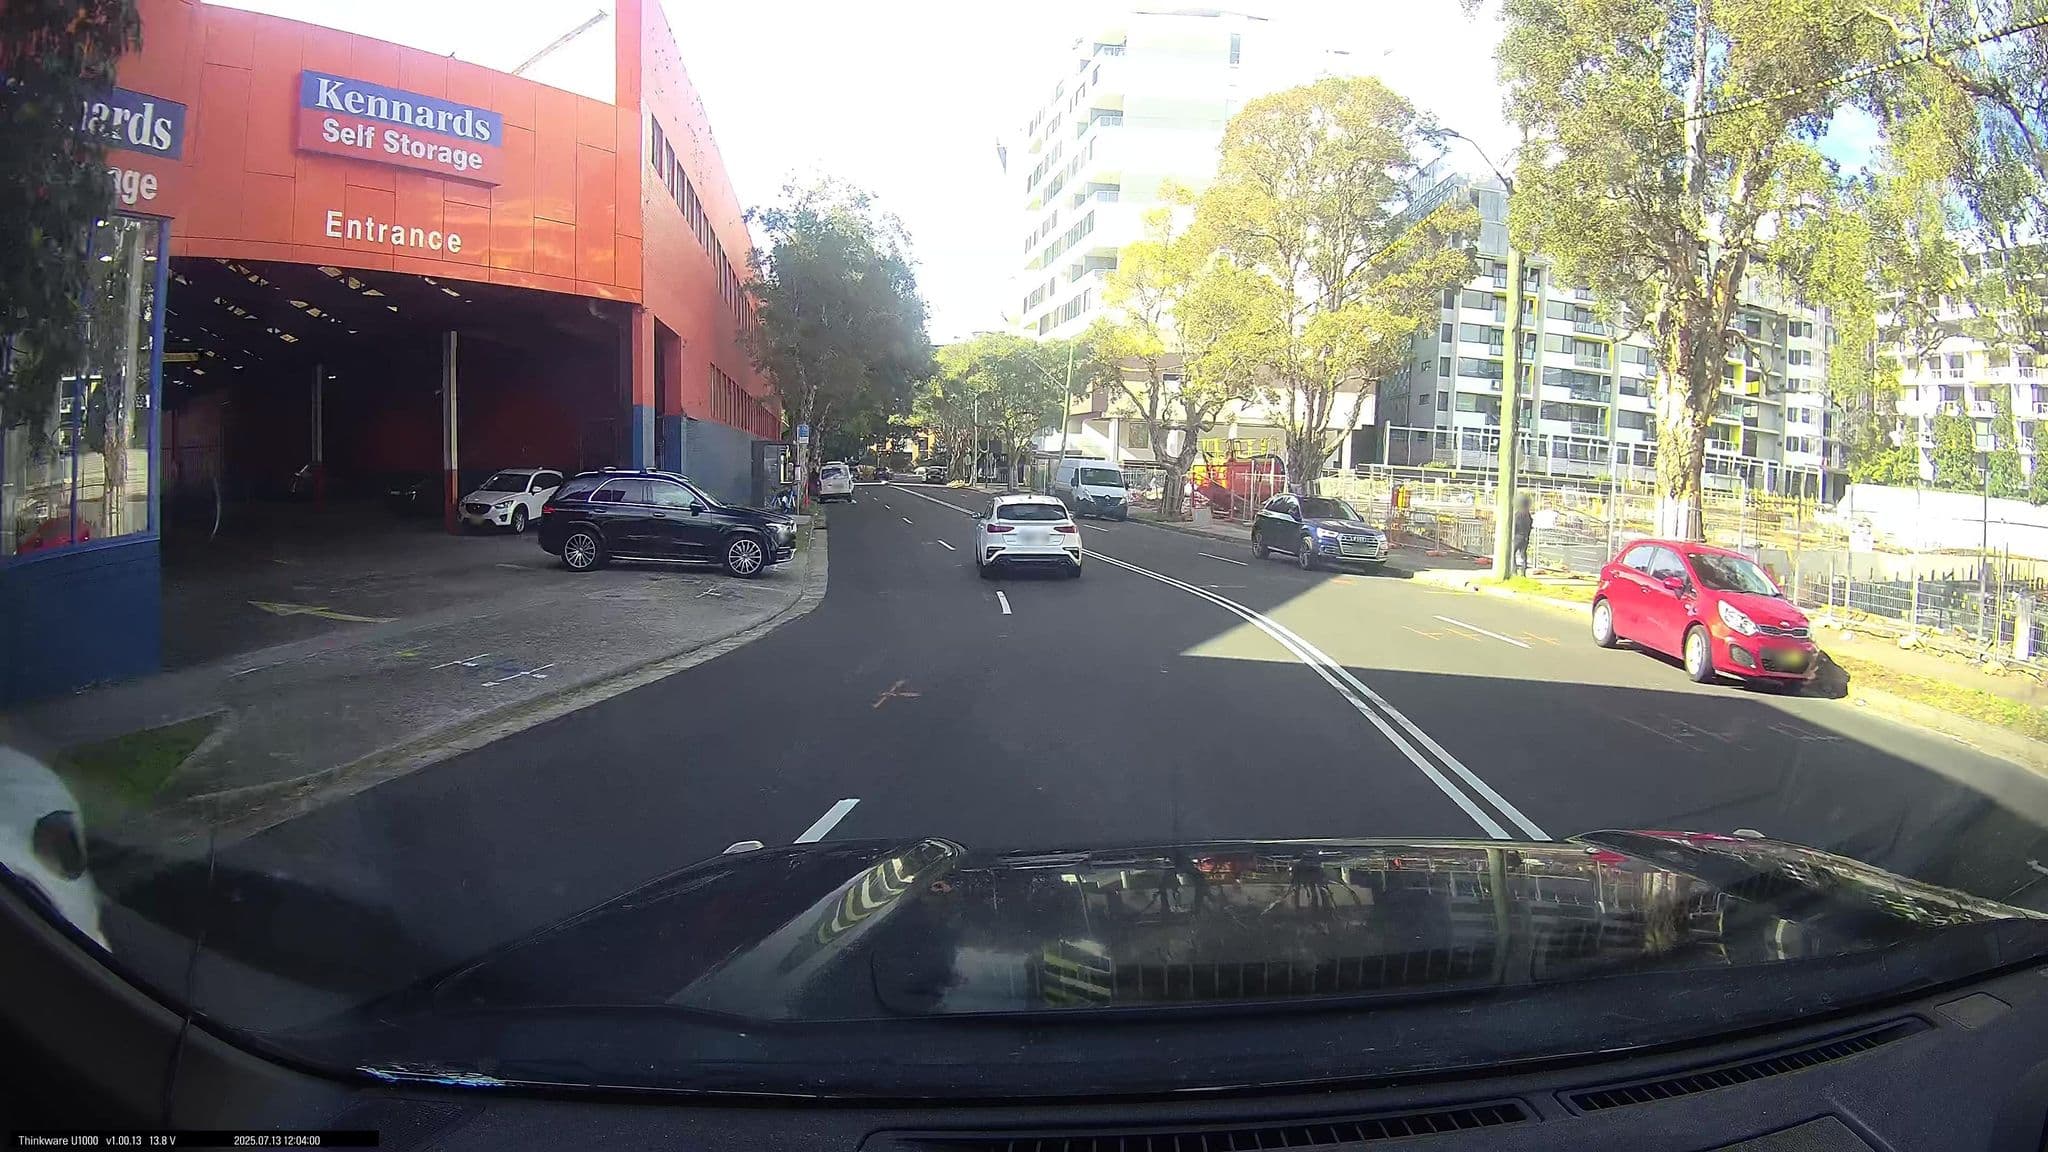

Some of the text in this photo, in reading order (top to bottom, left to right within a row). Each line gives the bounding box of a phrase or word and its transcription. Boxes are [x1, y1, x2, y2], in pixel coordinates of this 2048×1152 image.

[315, 77, 491, 142] Kennards
[322, 118, 483, 171] Self Storage
[326, 210, 462, 253] Entrance
